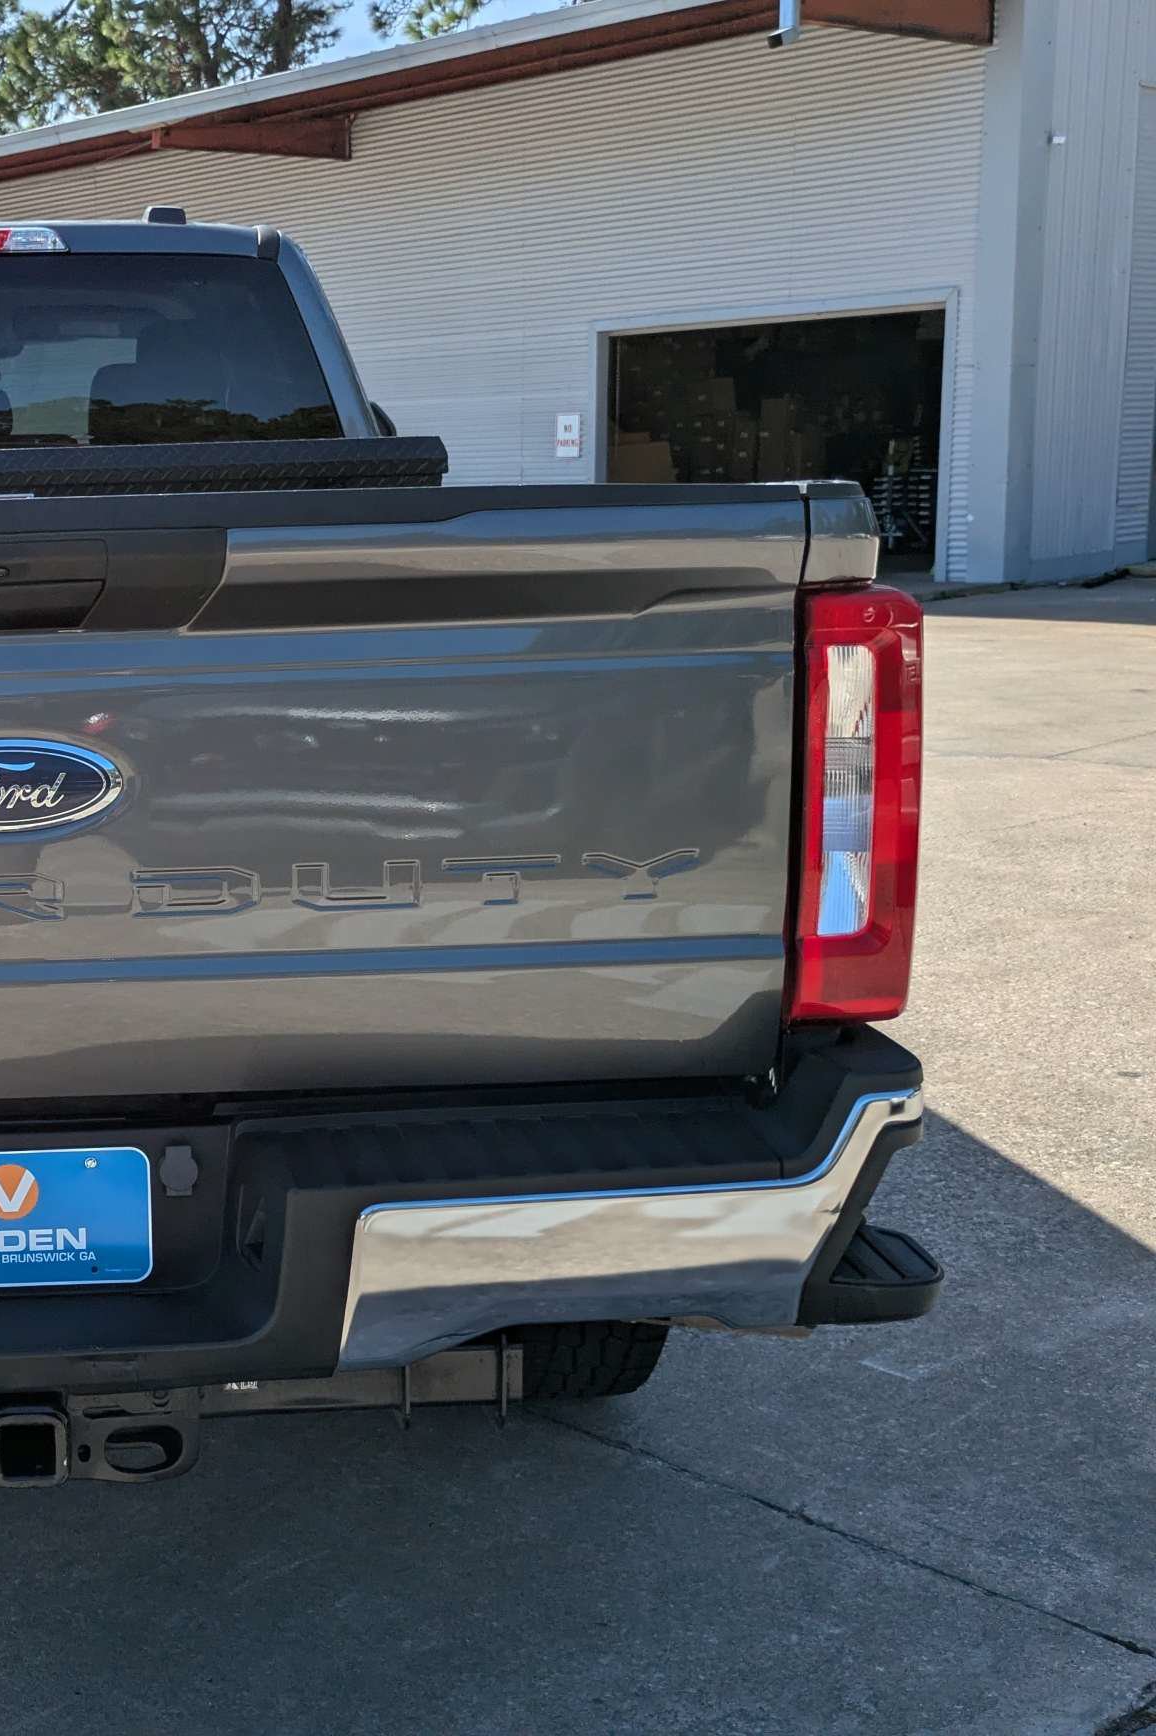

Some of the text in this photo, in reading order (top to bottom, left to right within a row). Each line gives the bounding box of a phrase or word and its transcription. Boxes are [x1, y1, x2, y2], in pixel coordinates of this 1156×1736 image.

[564, 424, 572, 432] NO
[129, 848, 701, 919] DUTY
[1, 1252, 75, 1264] BRUNSWICK
[79, 1251, 96, 1261] GA
